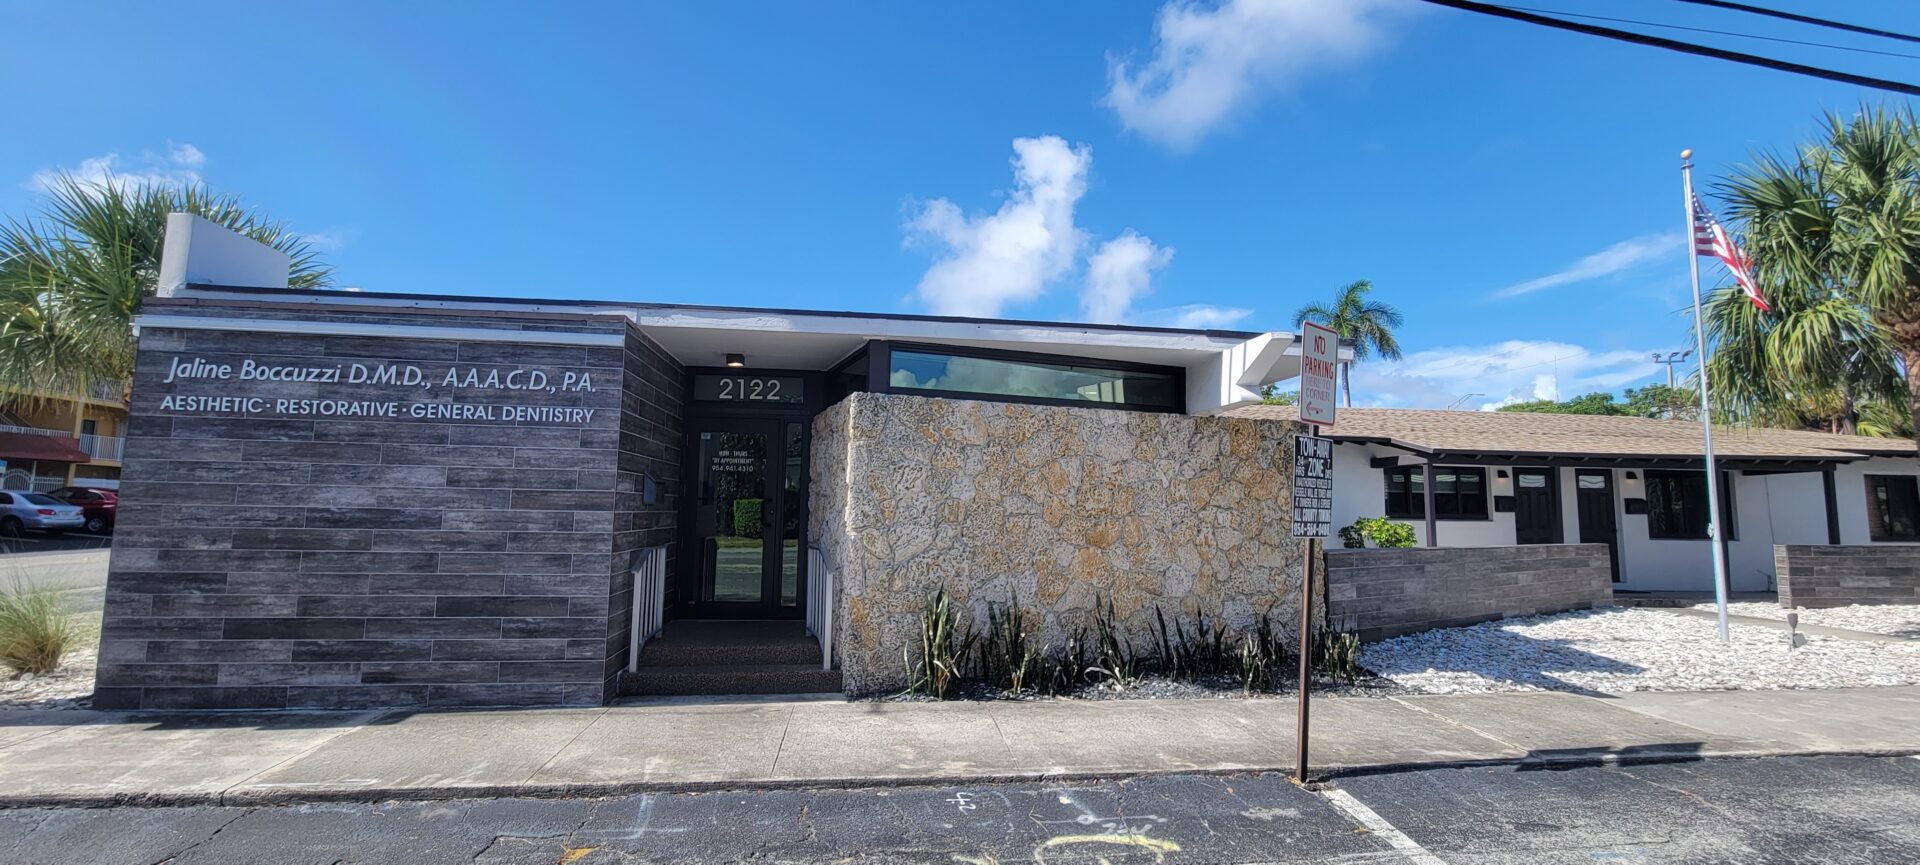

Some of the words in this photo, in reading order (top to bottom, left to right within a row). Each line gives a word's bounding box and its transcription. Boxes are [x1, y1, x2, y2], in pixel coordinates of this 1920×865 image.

[1314, 335, 1326, 355] NO
[163, 356, 232, 383] Jaline
[240, 359, 342, 382] Boccuzzi
[348, 363, 431, 390] D.M.D.,
[442, 367, 556, 394] A.A.A.C.D.,
[562, 371, 596, 392] P.A.
[1305, 356, 1334, 380] PARKING
[719, 378, 781, 400] 2122
[1305, 387, 1331, 402] CORNER
[160, 395, 264, 413] AESTHETIC
[276, 399, 398, 417] RESTORATIVE
[410, 403, 496, 420] GENERAL
[502, 406, 595, 423] DENTISTRY
[1307, 458, 1324, 477] ZONE
